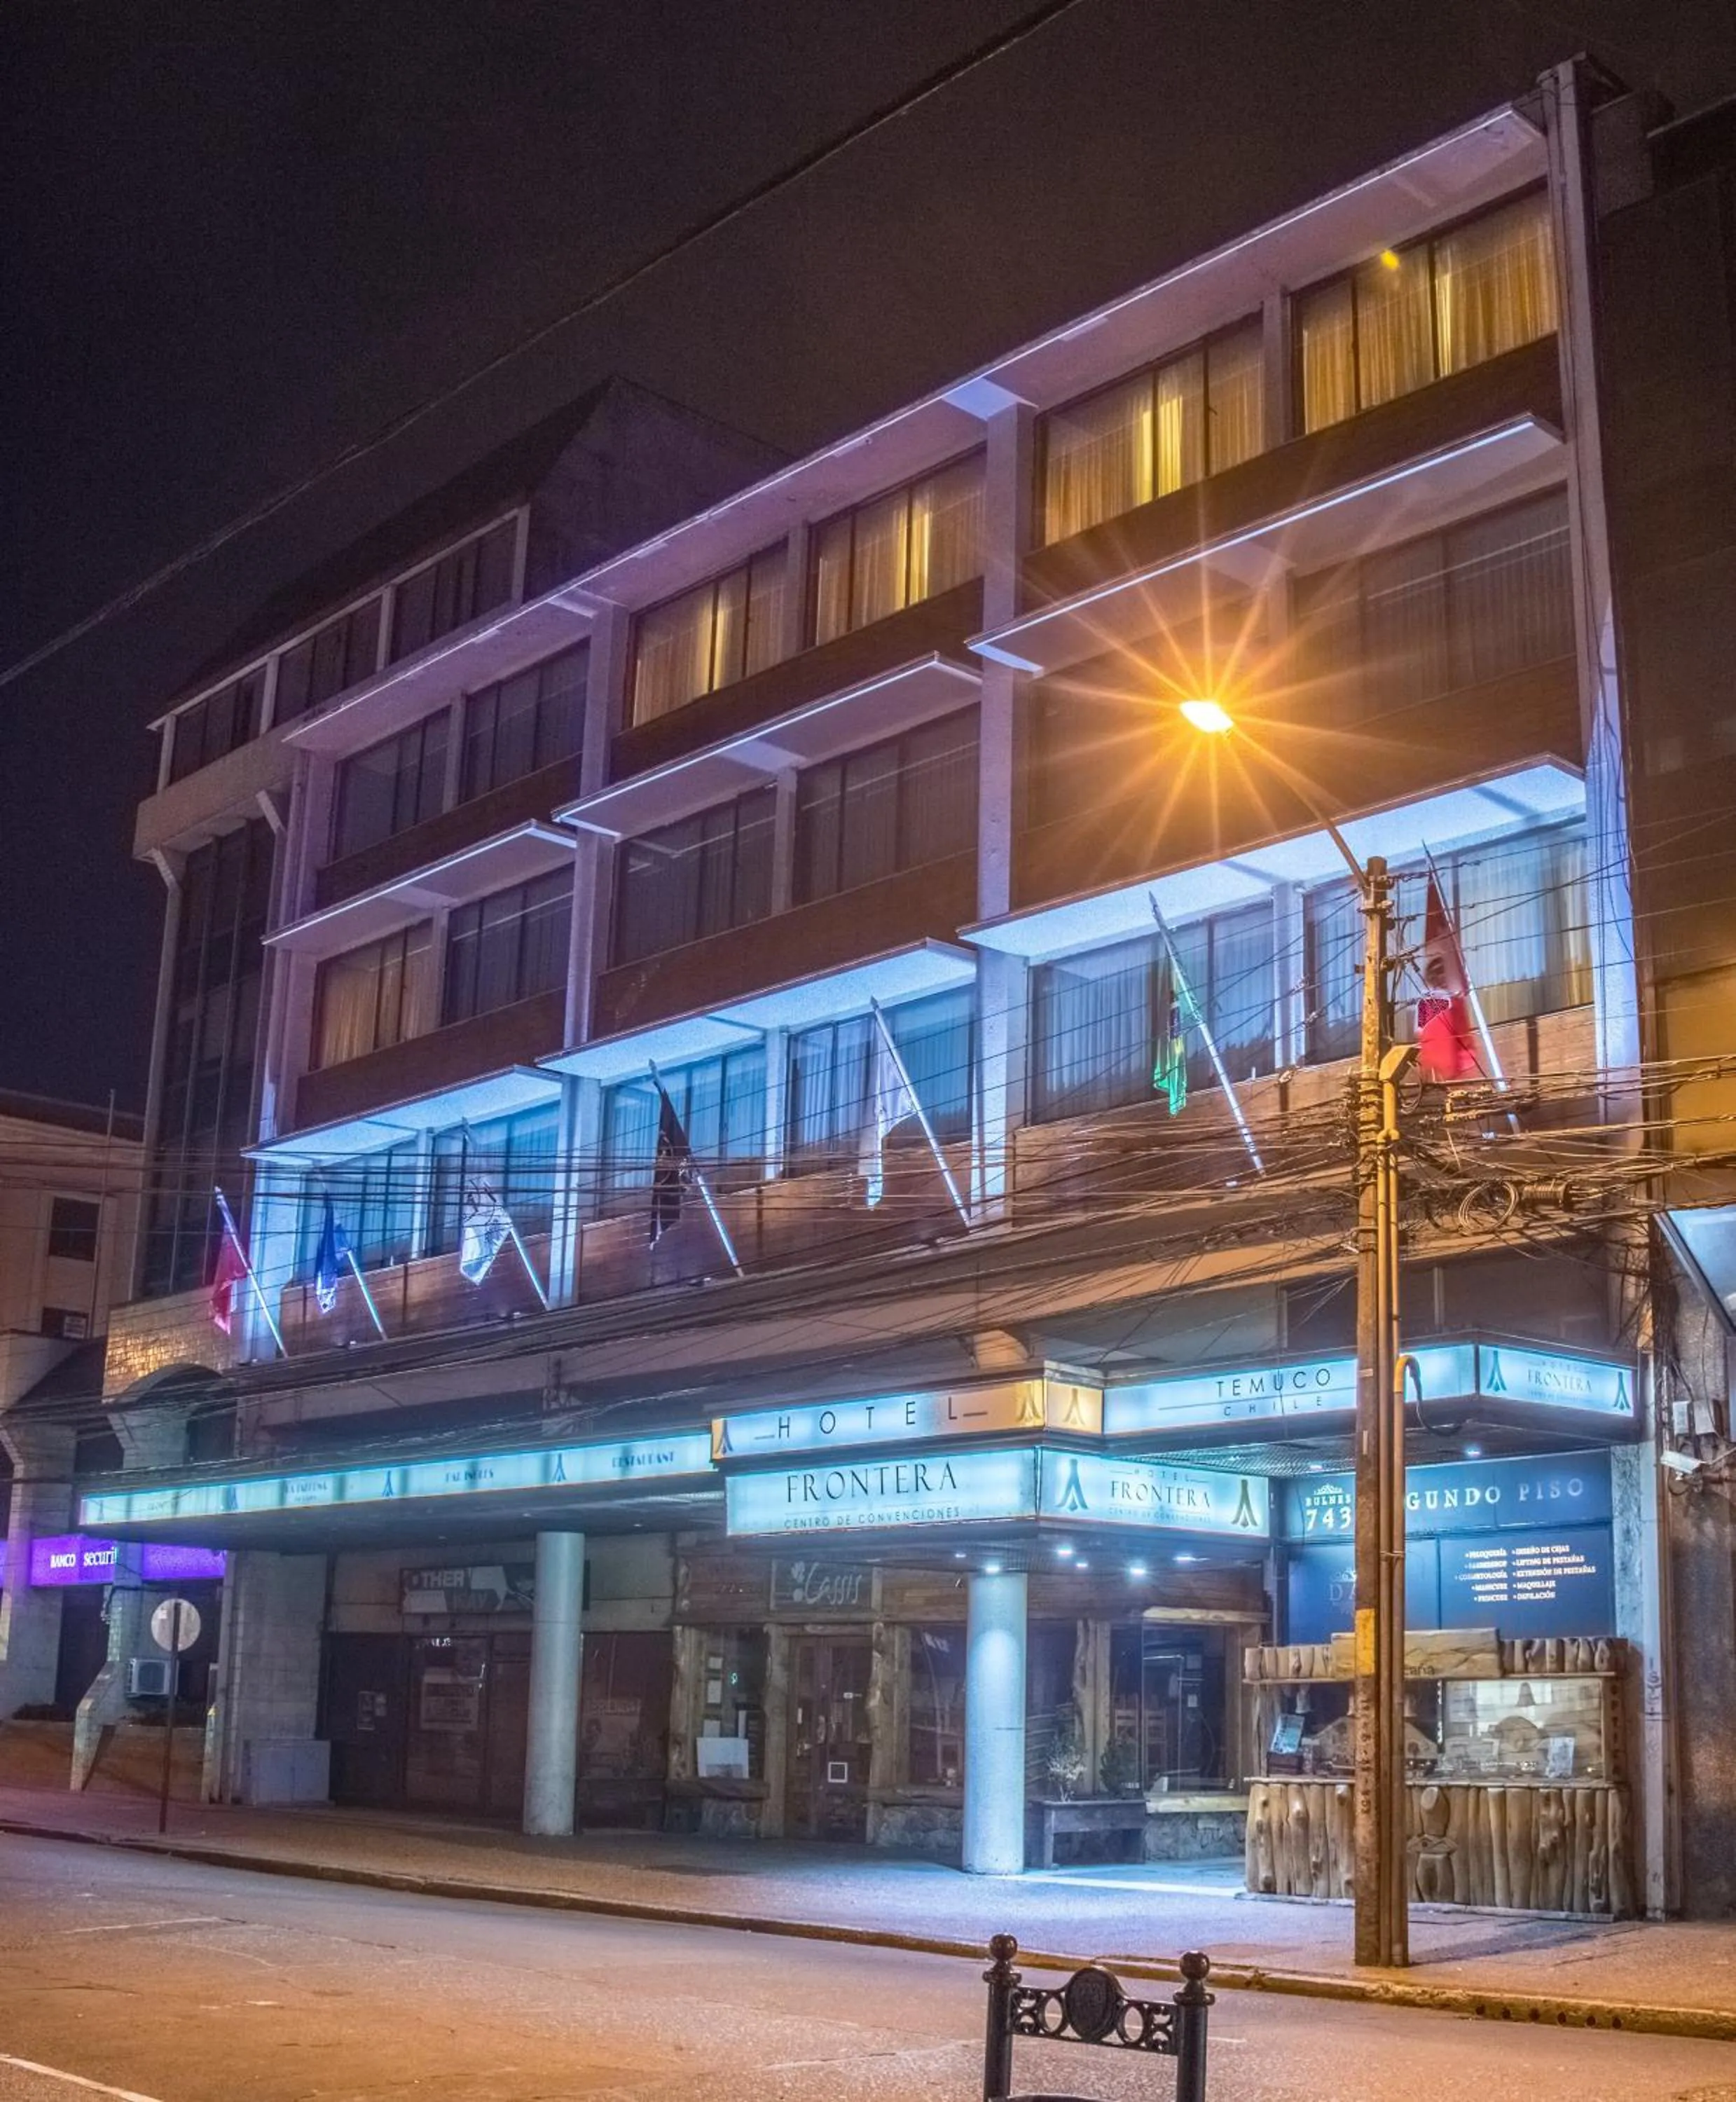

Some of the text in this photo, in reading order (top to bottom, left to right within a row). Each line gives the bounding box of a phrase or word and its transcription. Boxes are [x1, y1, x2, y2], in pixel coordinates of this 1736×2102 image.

[1216, 1368, 1331, 1398] TEMUCO
[778, 1396, 958, 1438] HOTEL
[1223, 1396, 1323, 1417] CHILE
[786, 1461, 958, 1504] FRONTERA
[1111, 1479, 1211, 1509] FRONTERA
[1405, 1477, 1585, 1511] GUNDO PISO
[784, 1506, 960, 1530] CENTRO DE CONVENCIONES
[1306, 1506, 1352, 1532] 743
